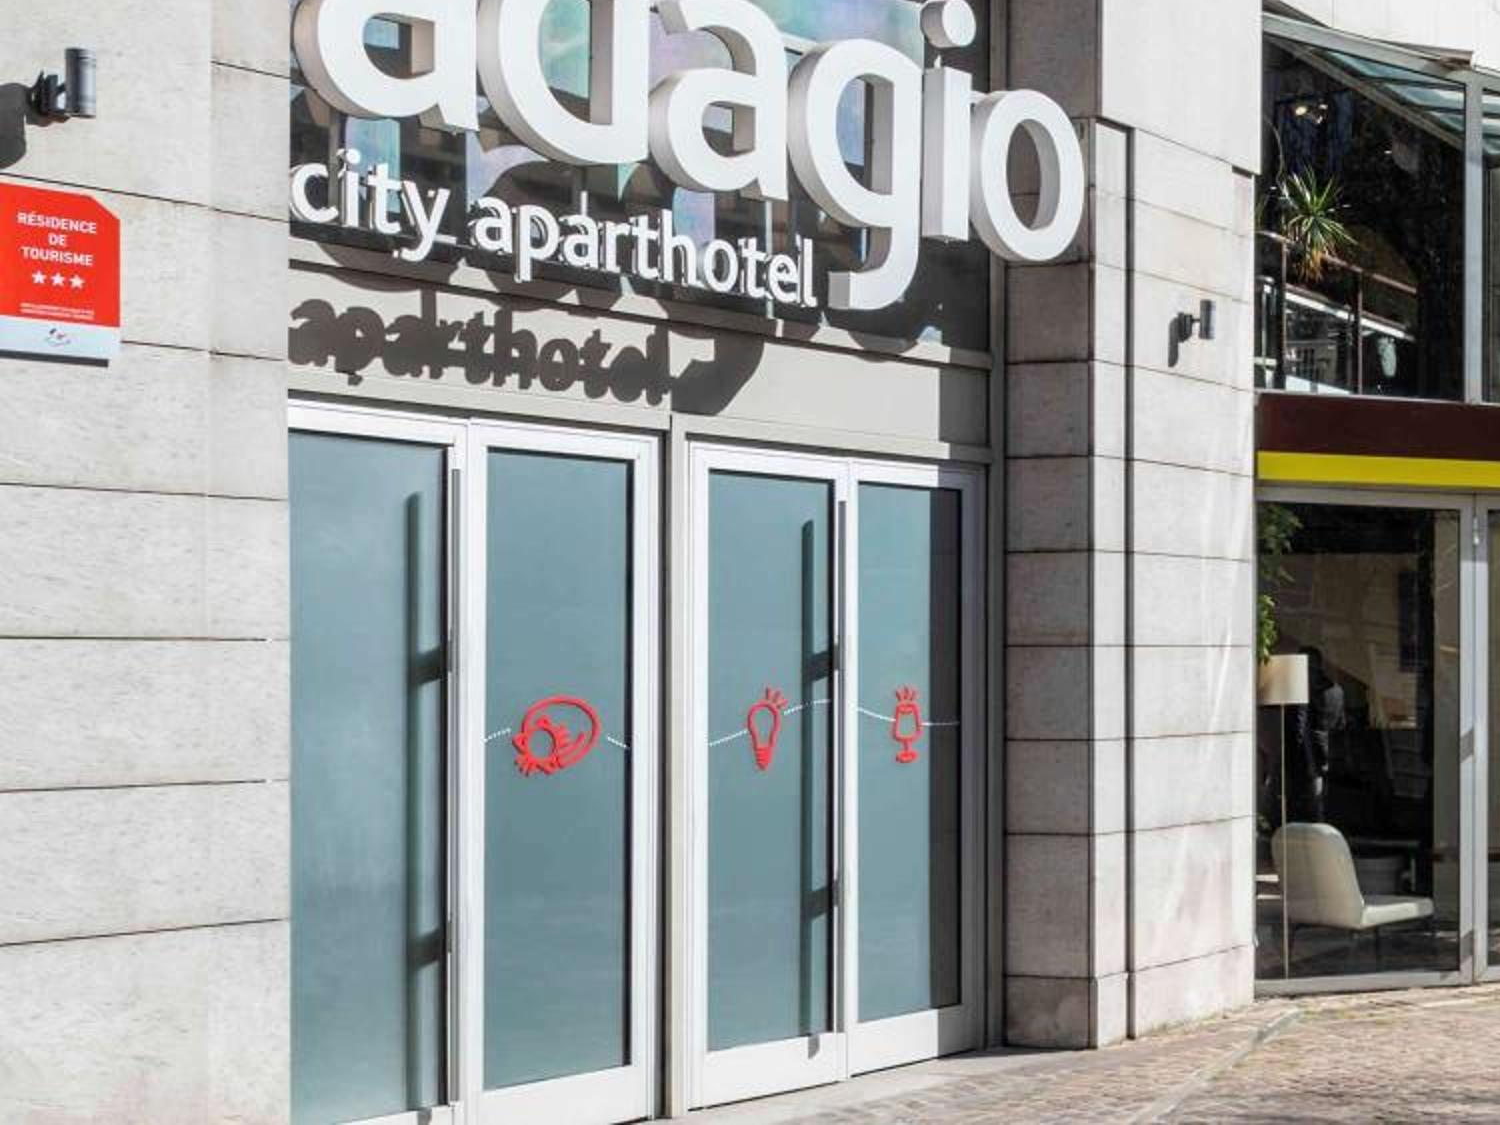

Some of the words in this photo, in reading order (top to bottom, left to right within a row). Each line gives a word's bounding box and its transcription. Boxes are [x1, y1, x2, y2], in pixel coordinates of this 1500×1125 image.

[17, 211, 97, 235] RÉSIDENCE
[289, 150, 451, 263] city
[472, 195, 819, 309] aparthotel
[48, 232, 67, 246] DE
[20, 245, 94, 266] TOURISME
